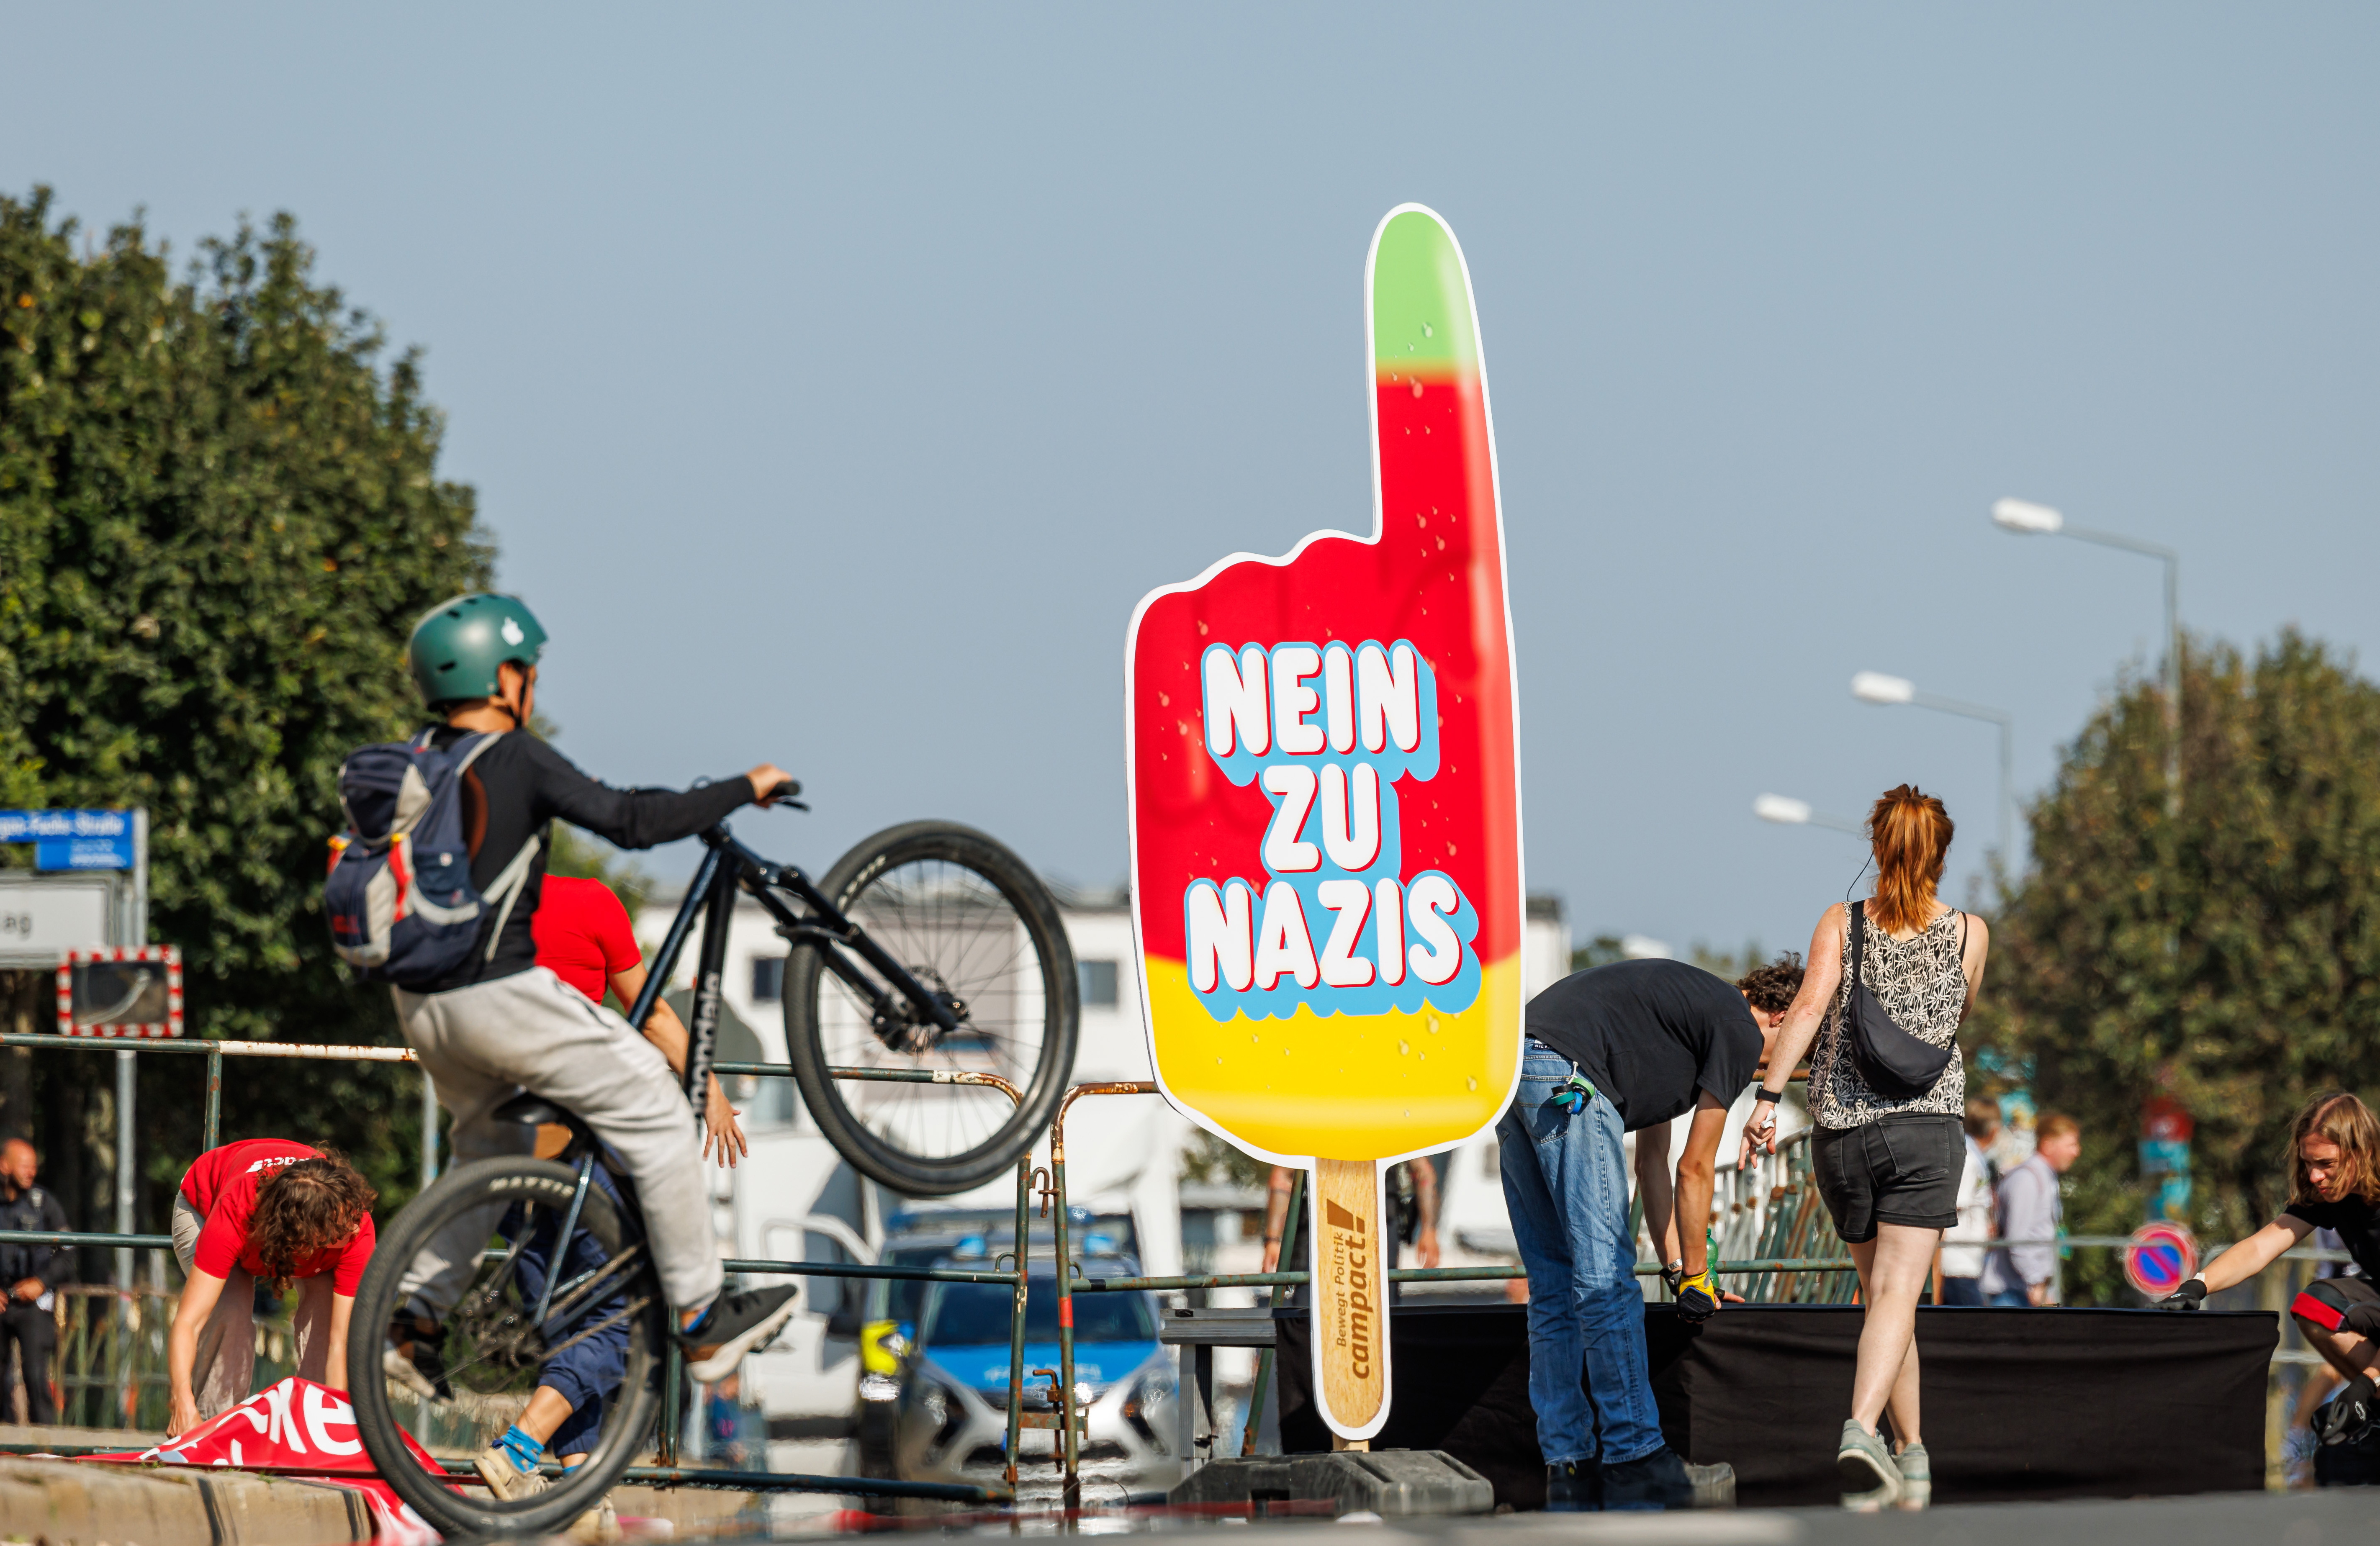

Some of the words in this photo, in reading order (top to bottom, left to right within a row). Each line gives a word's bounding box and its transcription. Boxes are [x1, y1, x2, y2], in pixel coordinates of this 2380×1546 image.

[1205, 645, 1421, 757] NEIN
[1263, 762, 1381, 873] ZU
[1188, 876, 1463, 994] NAZIS
[1334, 1231, 1345, 1286] Politik
[1336, 1291, 1348, 1348] Bewegt
